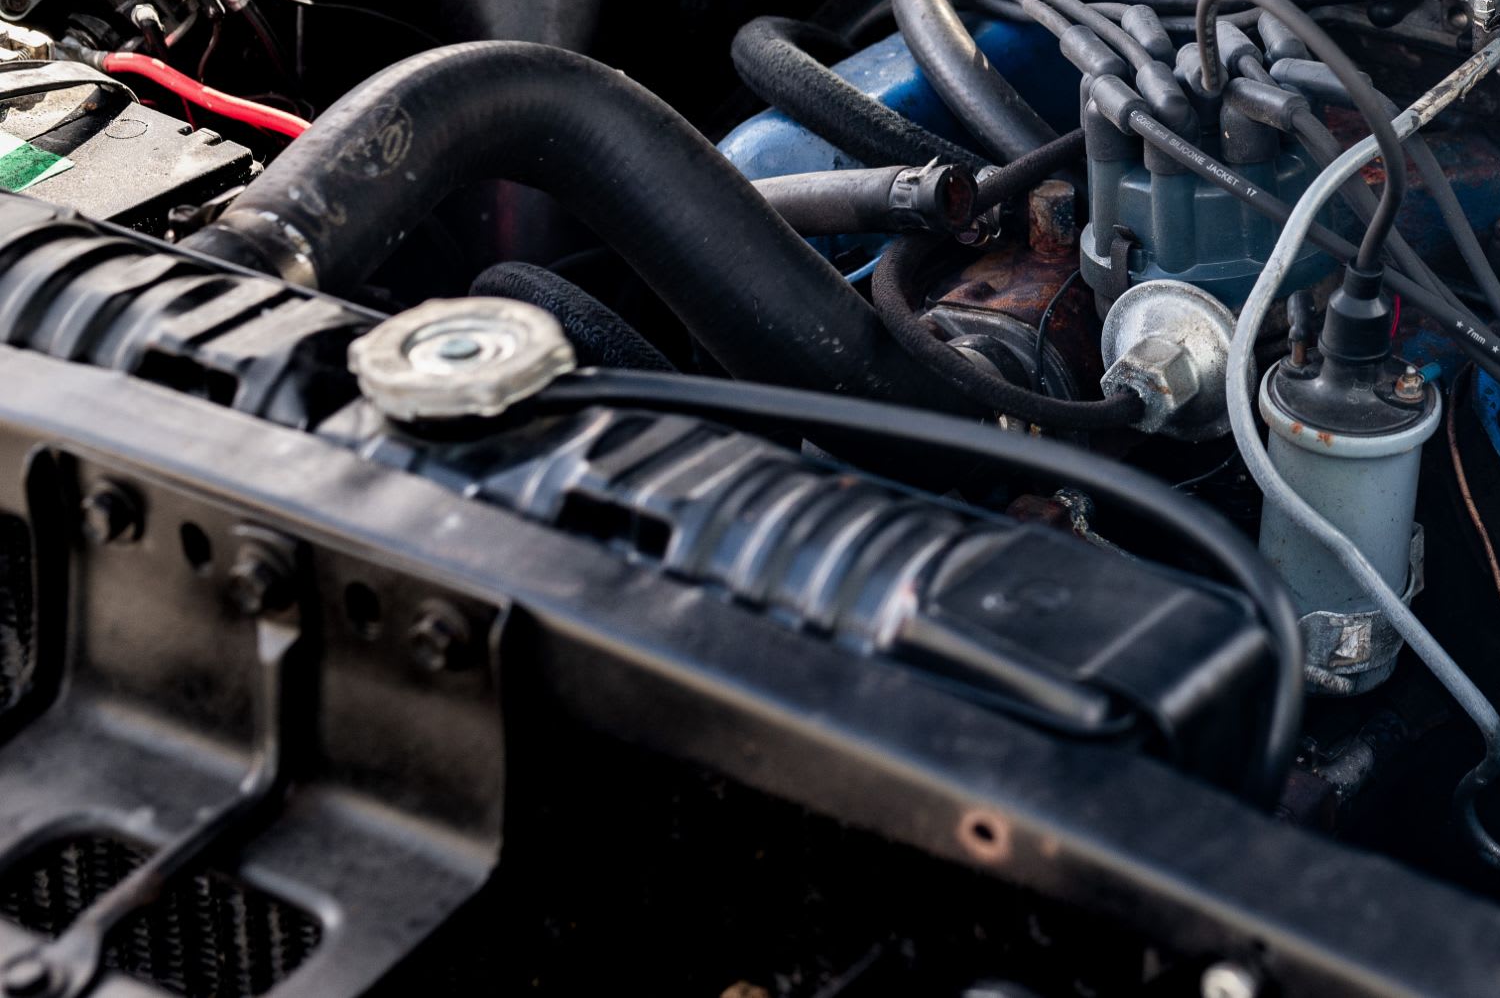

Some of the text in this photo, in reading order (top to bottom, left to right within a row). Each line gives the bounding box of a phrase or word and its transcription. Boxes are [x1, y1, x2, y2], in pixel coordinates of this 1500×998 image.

[1136, 114, 1155, 131] CORE
[1169, 138, 1206, 166] SILICONE
[1206, 163, 1240, 187] JACKET
[1246, 187, 1258, 197] 17
[1466, 327, 1487, 345] 7mm
